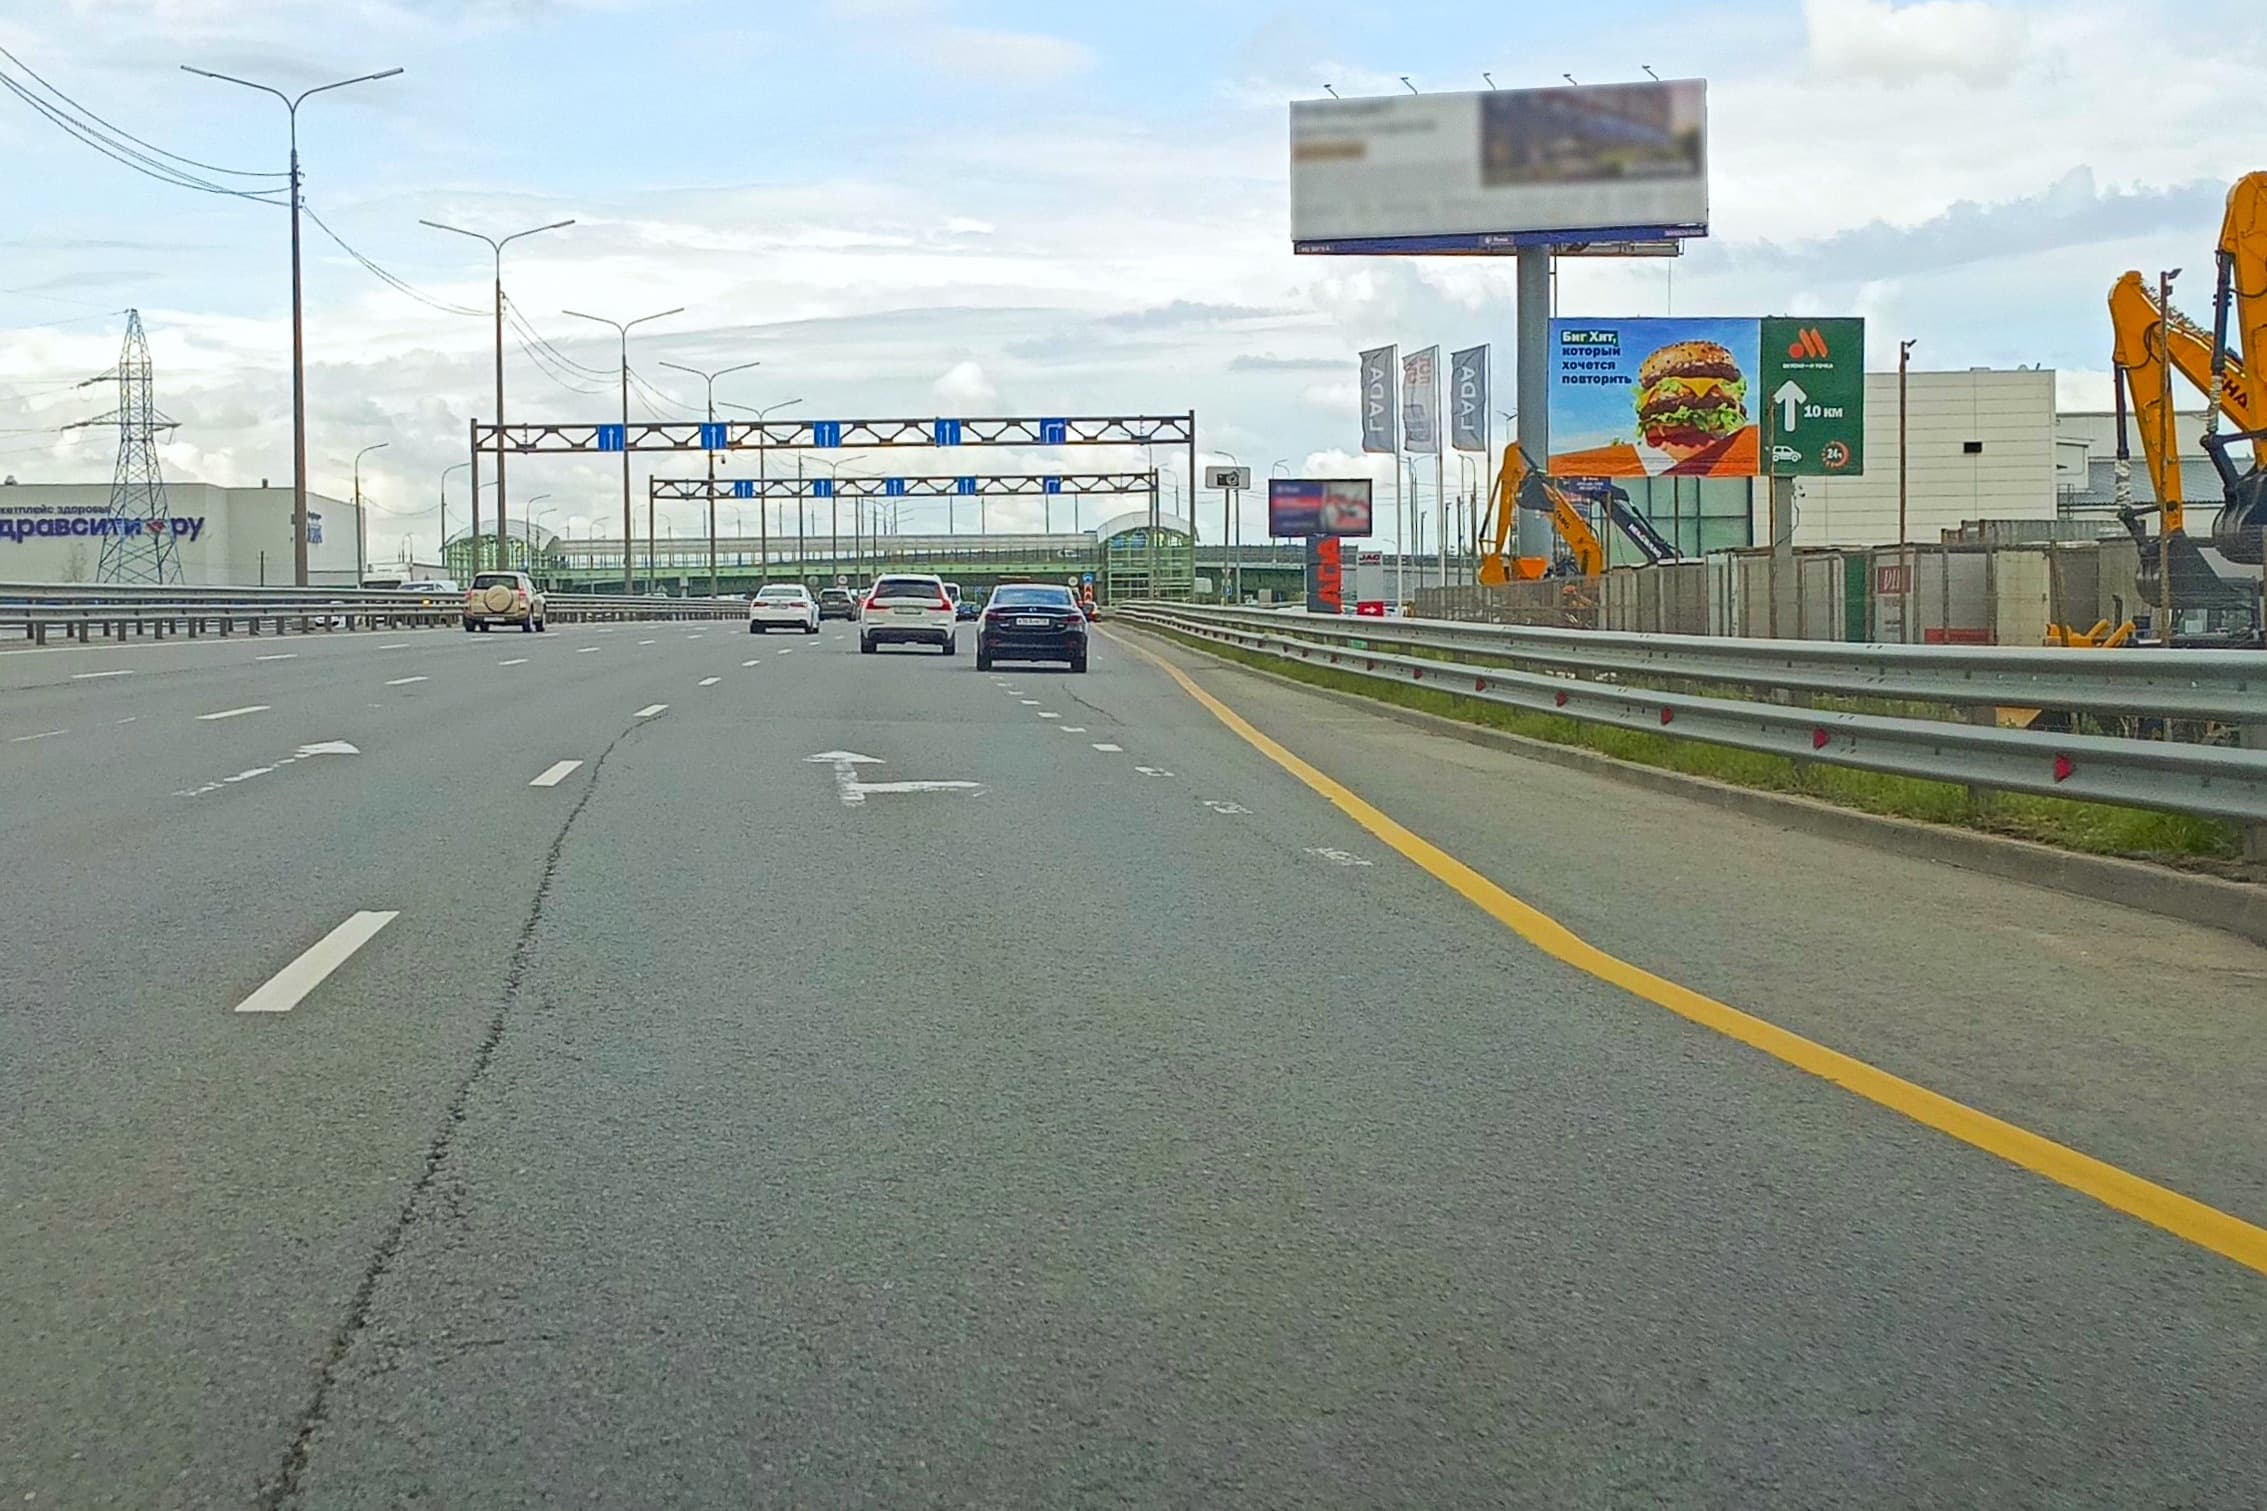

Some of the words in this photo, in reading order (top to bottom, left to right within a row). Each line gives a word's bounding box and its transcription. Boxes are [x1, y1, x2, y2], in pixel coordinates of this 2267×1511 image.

[1562, 331, 1587, 342] Биг
[1562, 347, 1620, 358] который
[1562, 361, 1616, 370] хочется
[1562, 375, 1632, 385] повторить
[1804, 405, 1820, 418] 10
